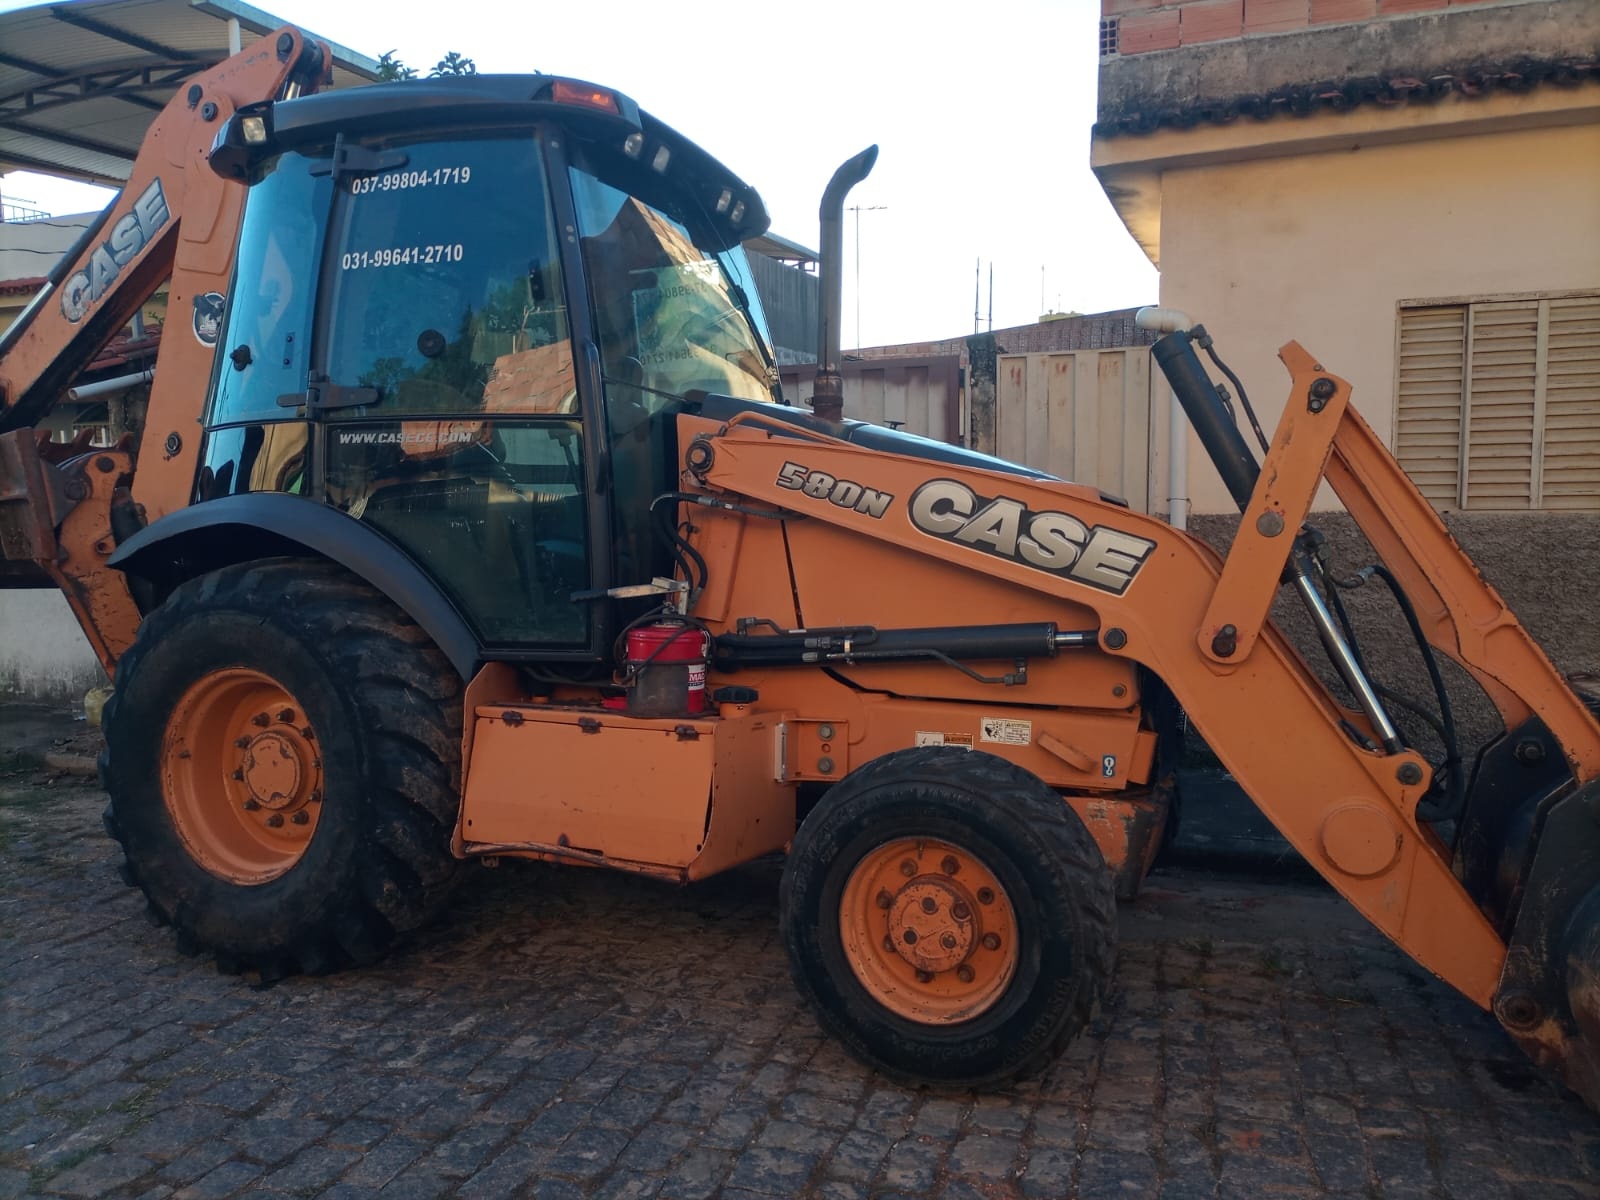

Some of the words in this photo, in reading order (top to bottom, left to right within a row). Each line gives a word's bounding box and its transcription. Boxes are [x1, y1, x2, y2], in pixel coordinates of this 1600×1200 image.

[352, 166, 471, 195] 037-99804-1719
[61, 177, 170, 323] CASE
[342, 244, 464, 270] 031-99641-2710
[339, 432, 472, 444] WWW.CASECE.COM
[776, 461, 895, 519] 580N
[908, 478, 1156, 596] CASE
